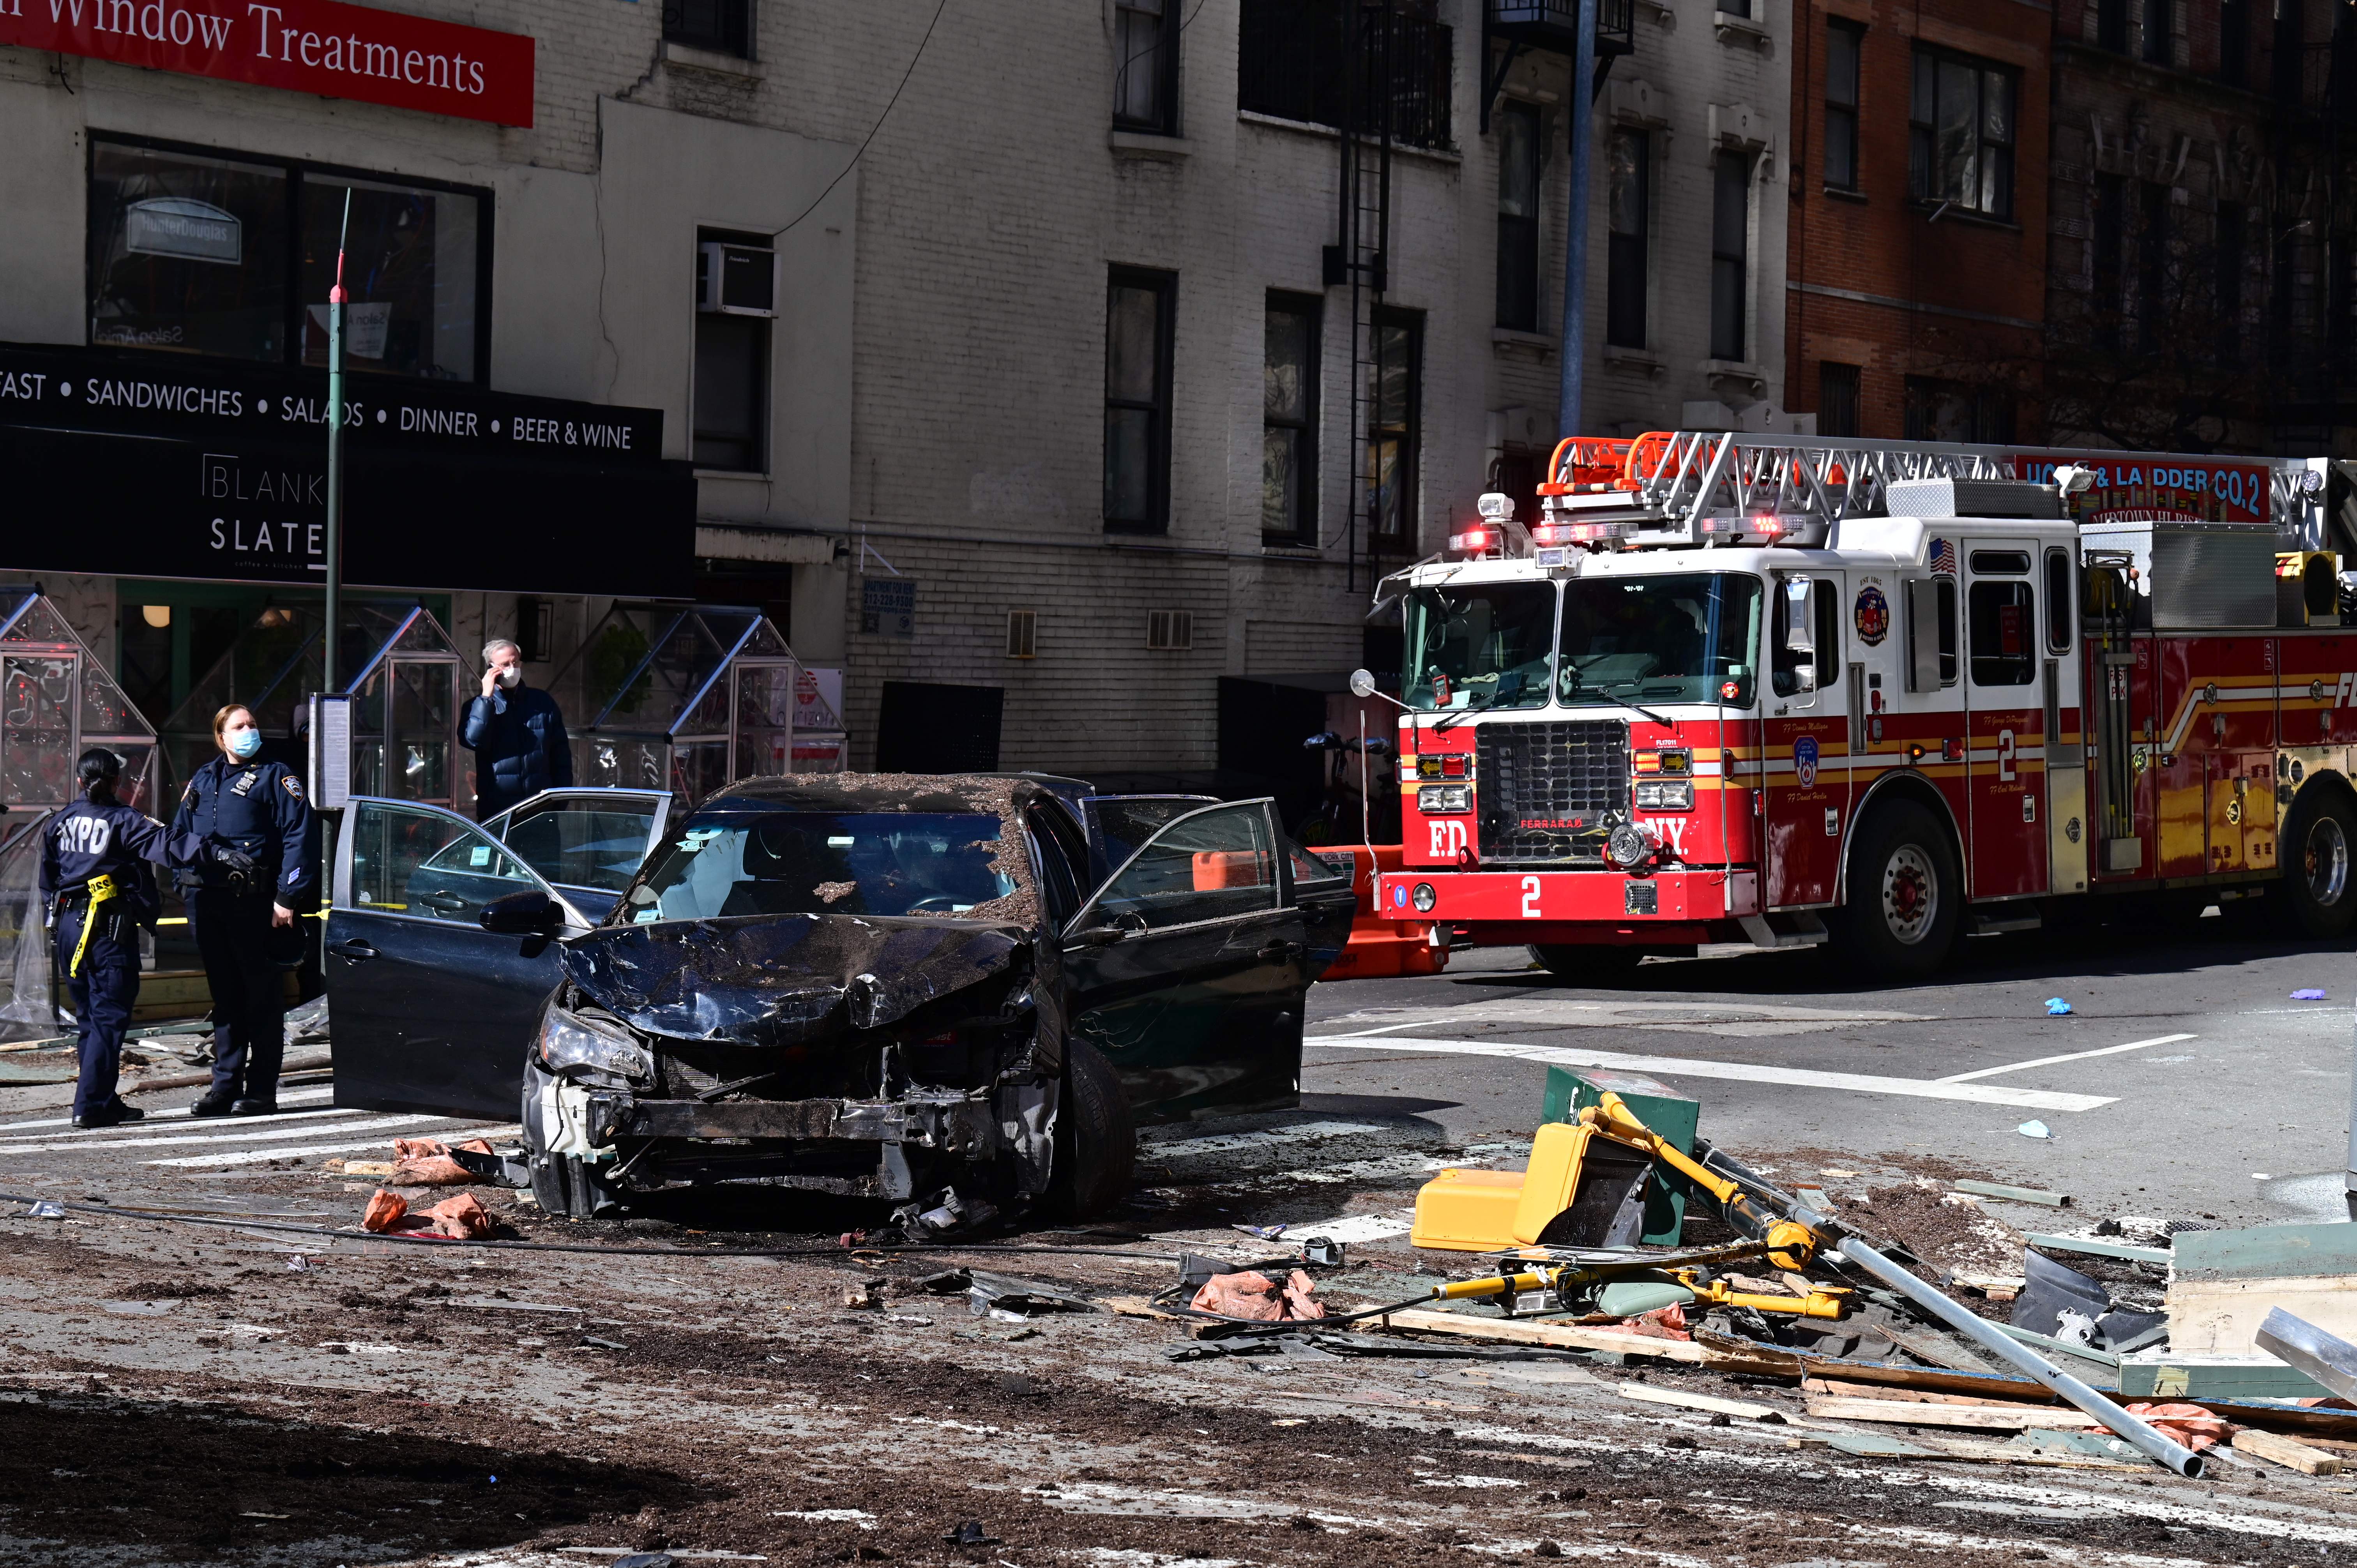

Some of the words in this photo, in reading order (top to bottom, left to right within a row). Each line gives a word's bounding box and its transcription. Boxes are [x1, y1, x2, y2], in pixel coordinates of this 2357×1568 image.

[248, 3, 484, 94] Treatments
[86, 378, 242, 417] SANDWICHES
[401, 406, 478, 436] DINNER
[513, 417, 560, 444] BEER
[565, 421, 578, 445] &
[582, 423, 632, 449] WINE
[2096, 467, 2109, 488] &
[212, 466, 324, 505] BLANK
[2092, 510, 2154, 524] MIDTOWN
[210, 518, 323, 555] SLATE
[864, 580, 892, 593] APARTMENT
[892, 582, 902, 594] FOR
[903, 583, 915, 595] RENT
[1860, 577, 1869, 586] EST
[2110, 669, 2127, 681] FST
[2111, 686, 2126, 697] PK
[776, 711, 835, 726] hrizon
[1792, 723, 1807, 731] Dennis
[1808, 722, 1828, 732] Mulligan
[1999, 729, 2015, 781] 2
[1796, 793, 1811, 801] Daniel
[1521, 819, 1574, 828] FERRARA
[57, 816, 110, 855] NYPD
[1521, 876, 1541, 917] 2
